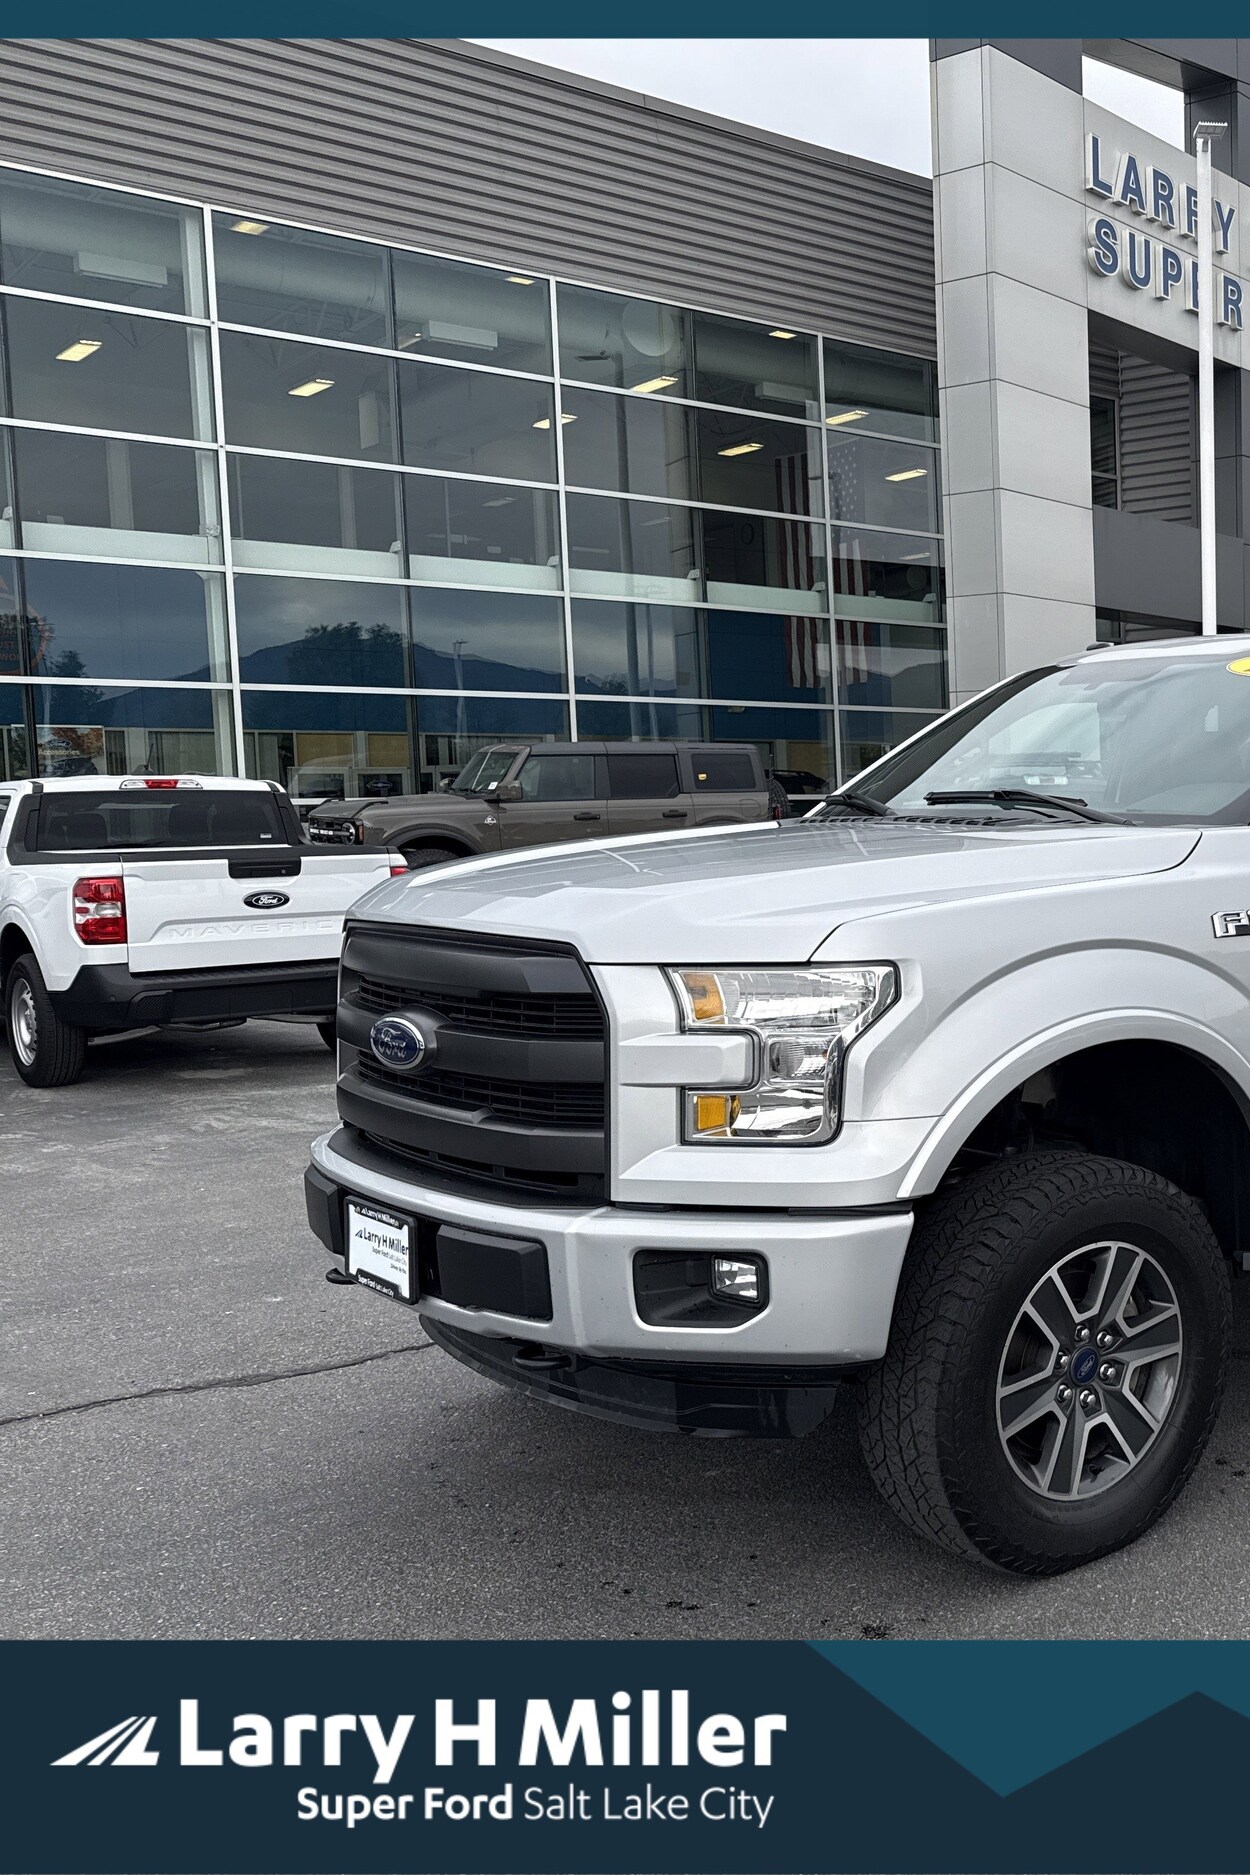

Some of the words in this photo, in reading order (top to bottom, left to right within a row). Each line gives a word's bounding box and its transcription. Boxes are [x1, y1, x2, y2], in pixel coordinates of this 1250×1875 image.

[1086, 132, 1236, 254] LARRY
[168, 918, 343, 939] MAVERIC
[363, 1227, 381, 1248] Larry
[382, 1234, 388, 1248] H
[388, 1237, 409, 1255] Miller
